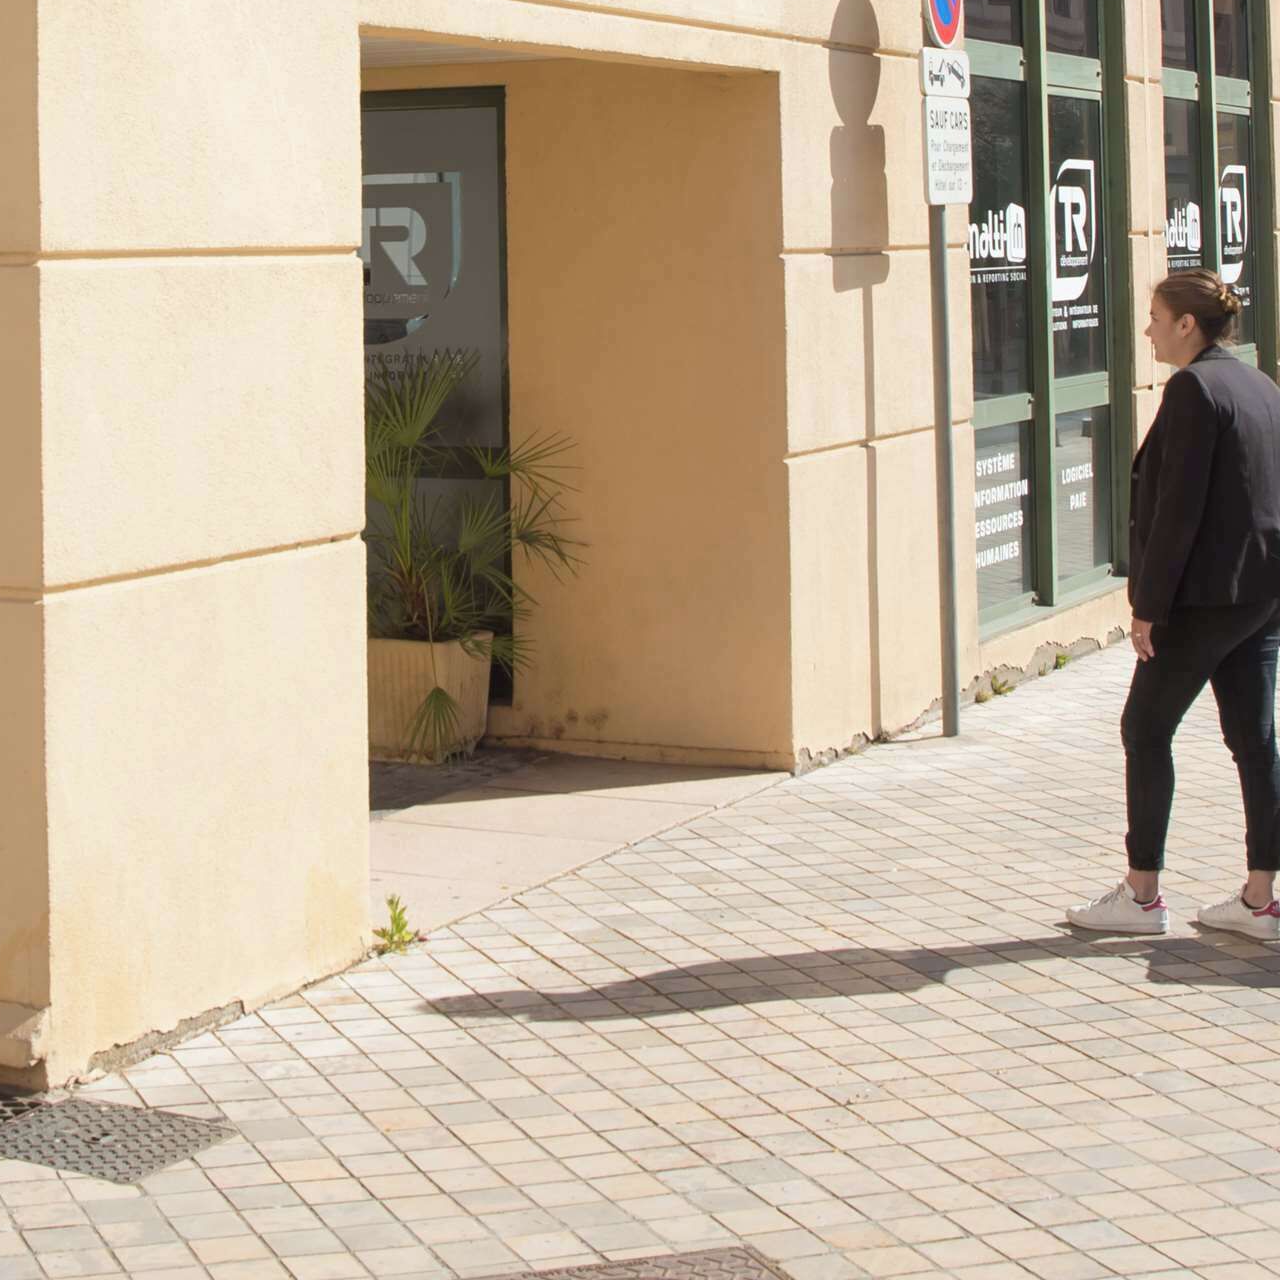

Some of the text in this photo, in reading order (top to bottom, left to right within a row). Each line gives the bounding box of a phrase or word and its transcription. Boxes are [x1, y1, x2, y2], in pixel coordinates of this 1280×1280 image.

[929, 109, 968, 130] SAUF CARS
[976, 453, 1016, 477] SYSTÈME
[1061, 463, 1093, 485] LOGICIEL
[975, 478, 1028, 508] NFORMATION
[1069, 491, 1088, 511] PAIE
[976, 510, 1024, 539] ESSOURCES
